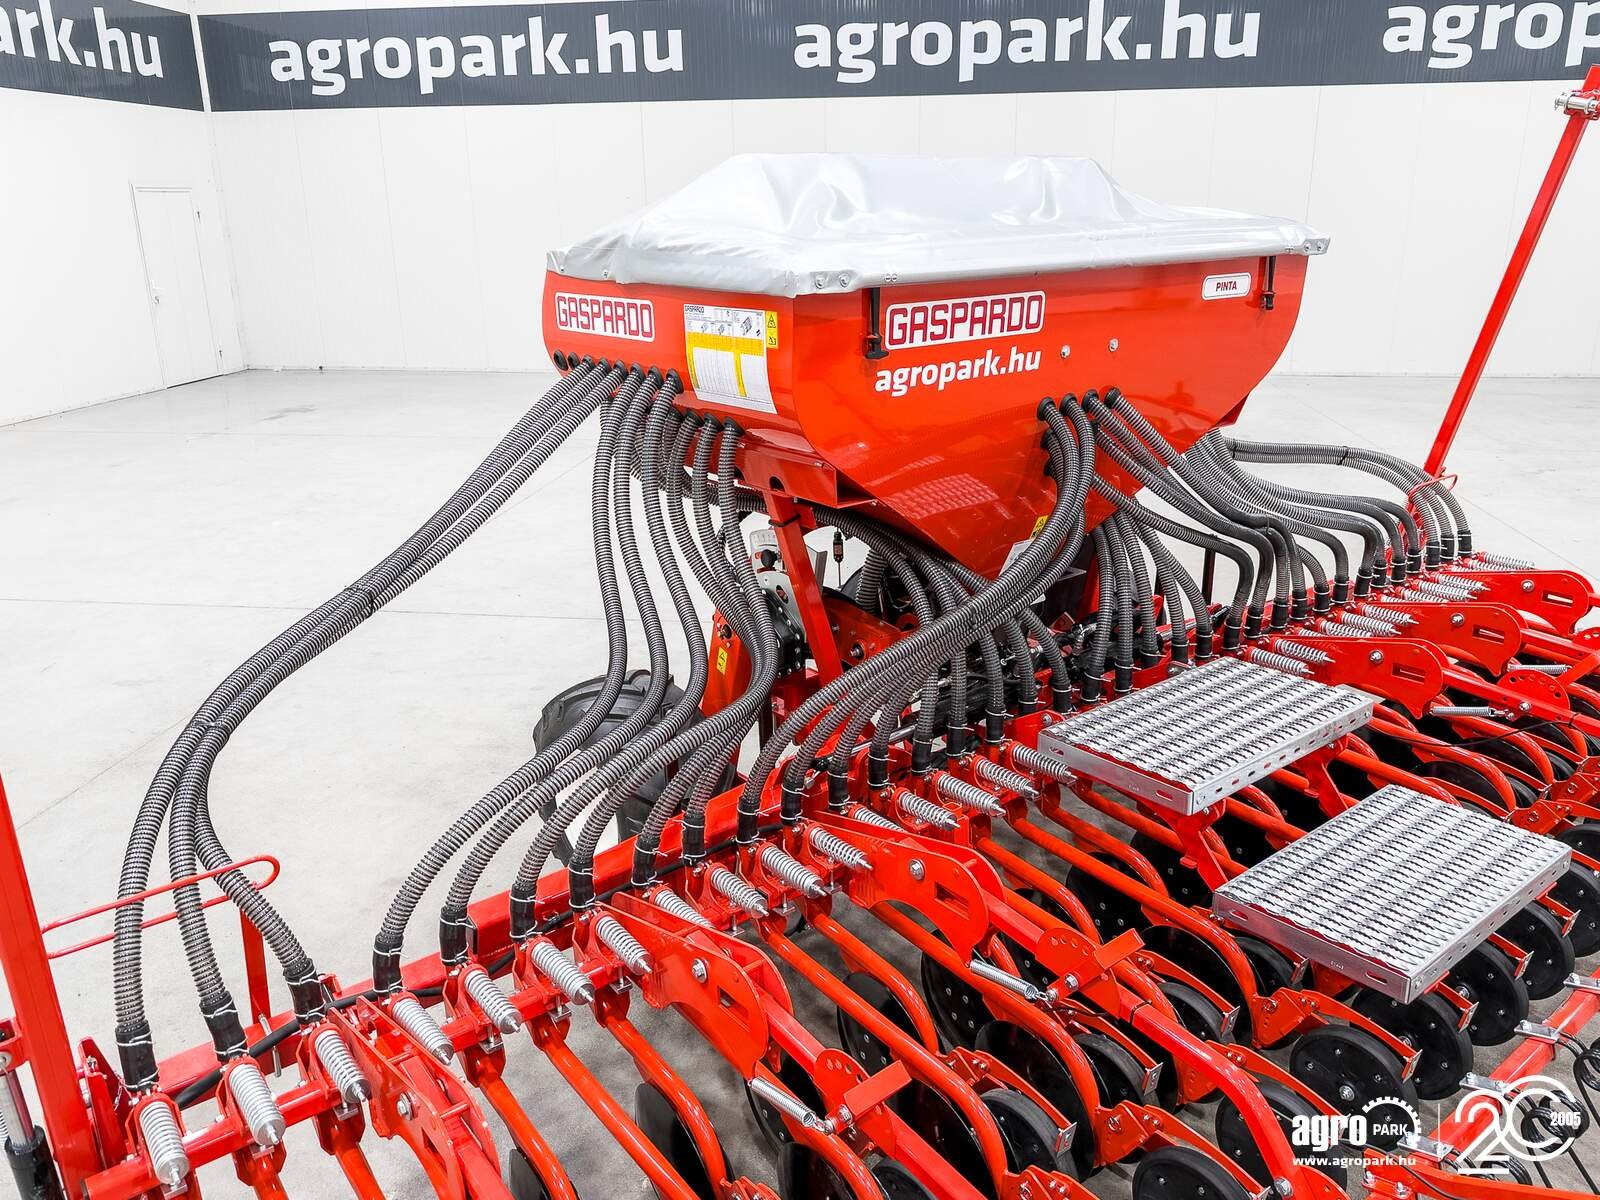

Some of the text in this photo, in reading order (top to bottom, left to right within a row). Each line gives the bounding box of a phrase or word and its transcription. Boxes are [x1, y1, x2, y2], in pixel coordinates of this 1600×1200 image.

[269, 13, 684, 96] agropark.hu
[794, 0, 1260, 83] agropark.hu
[1215, 281, 1238, 292] PINTA
[557, 295, 654, 338] GASPARDO
[888, 294, 1043, 345] GASPARDO
[875, 345, 1042, 397] agropark.hu
